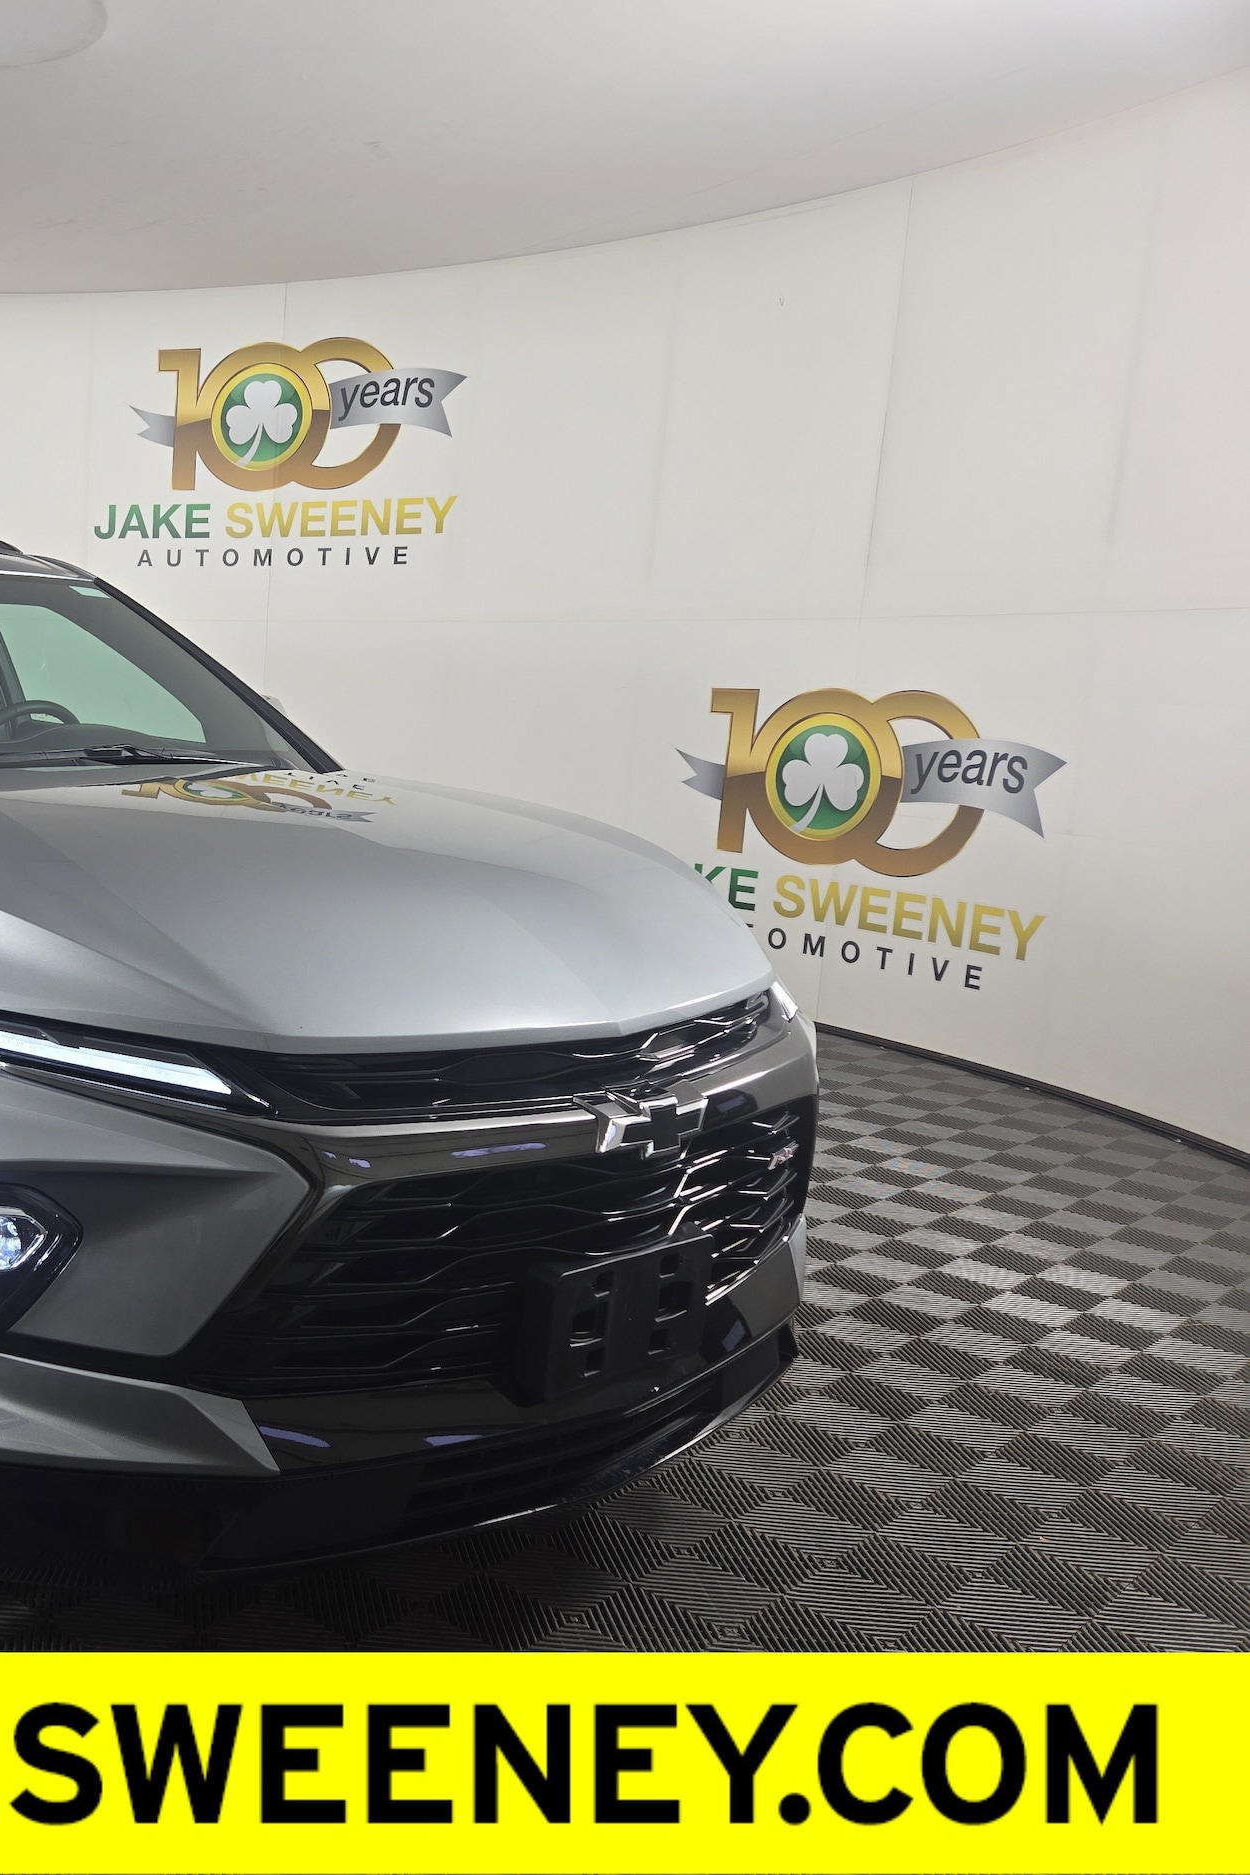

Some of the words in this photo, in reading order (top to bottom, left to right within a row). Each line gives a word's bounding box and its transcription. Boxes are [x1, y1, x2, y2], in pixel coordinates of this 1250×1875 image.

[338, 376, 436, 422] years
[93, 503, 211, 540] JAKE
[225, 495, 458, 540] SWEENEY
[137, 546, 409, 568] AUTOMOTIVE
[910, 748, 1029, 795] years
[773, 874, 1046, 962] SWEENEY
[746, 922, 984, 991] OMOTIVE
